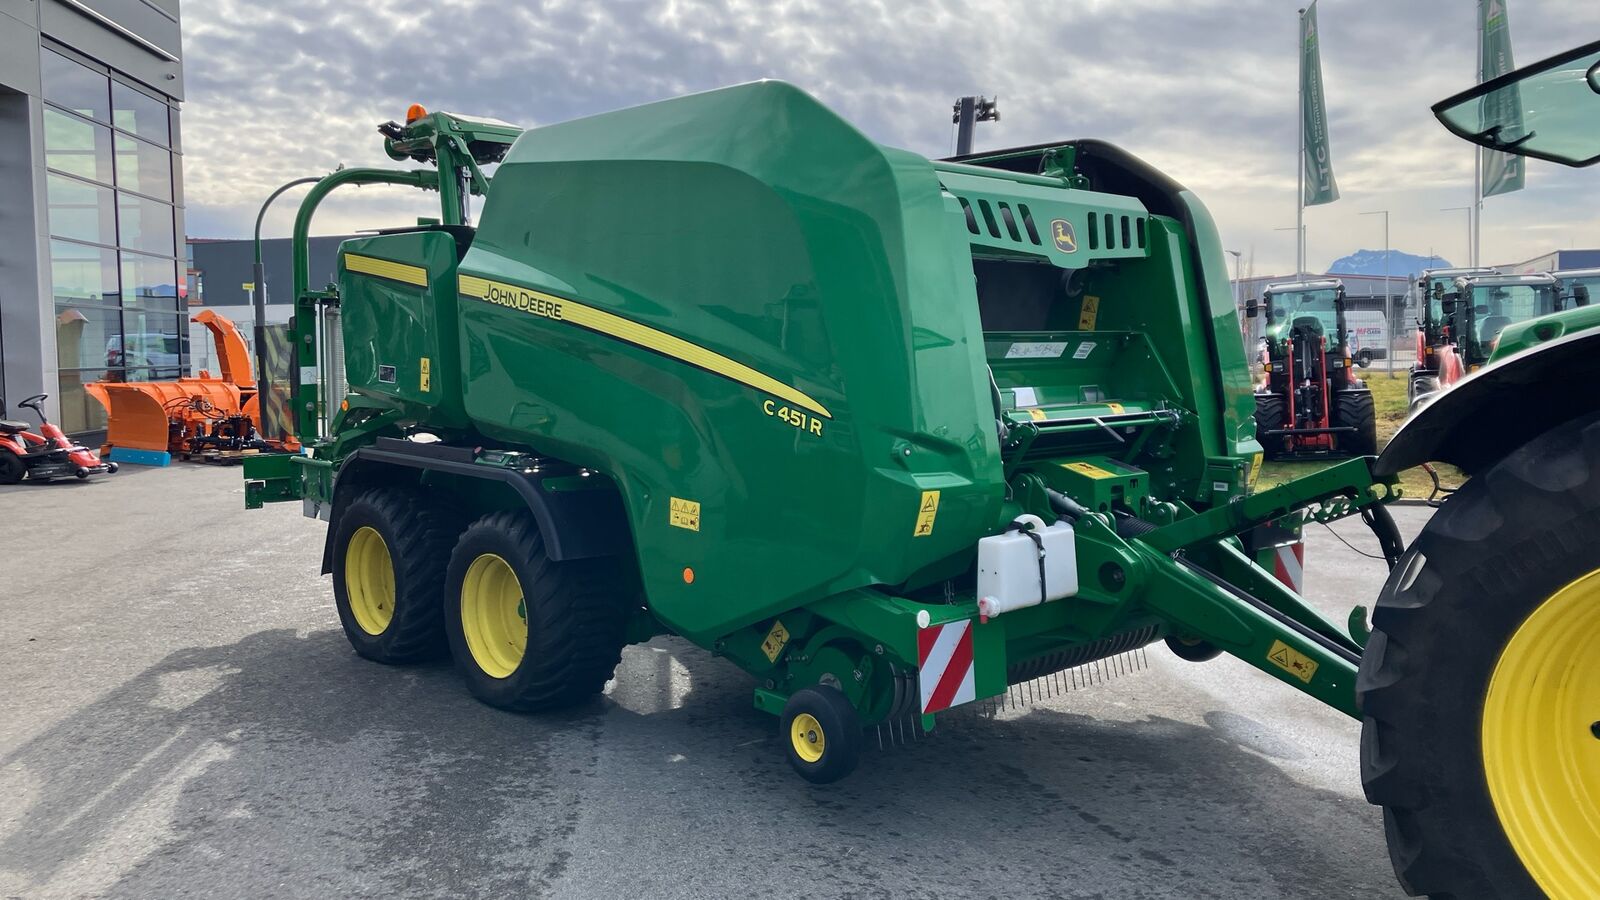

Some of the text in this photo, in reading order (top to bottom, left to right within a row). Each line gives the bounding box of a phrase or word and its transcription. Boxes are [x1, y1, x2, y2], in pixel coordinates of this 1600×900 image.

[1316, 145, 1329, 191] LTC
[483, 283, 562, 318] JOHN DEERE
[763, 399, 822, 436] C 451 R
